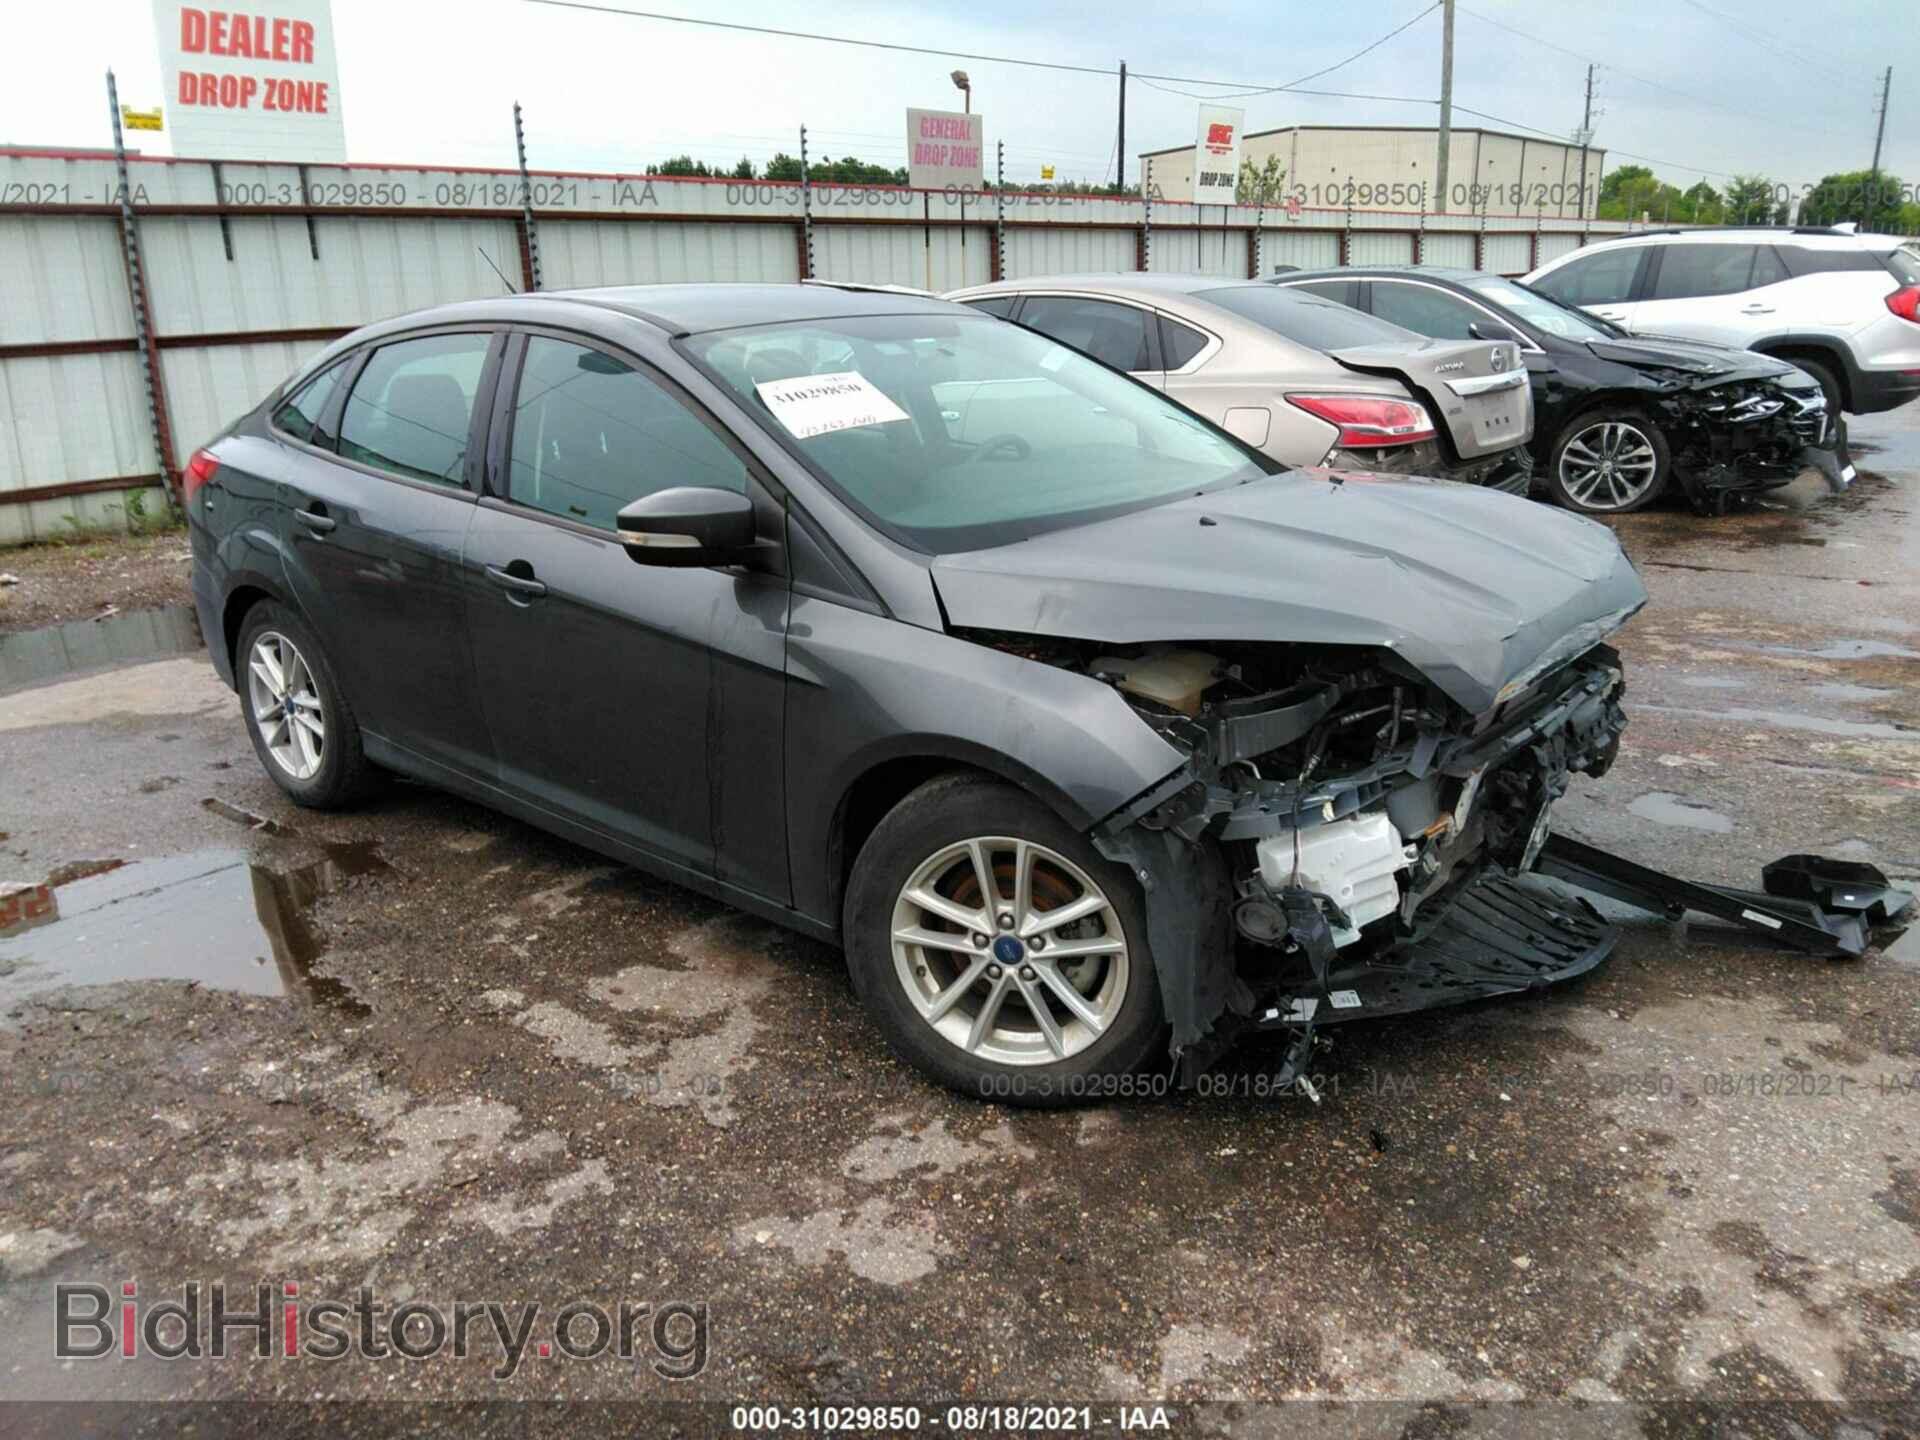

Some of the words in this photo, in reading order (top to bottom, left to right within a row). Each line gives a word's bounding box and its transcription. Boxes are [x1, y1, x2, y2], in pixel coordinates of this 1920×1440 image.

[180, 7, 314, 64] DEALER
[179, 71, 257, 108] DROP
[262, 77, 329, 114] ZONE
[920, 117, 971, 141] GENERAL
[913, 143, 949, 167] DROP
[949, 145, 979, 168] ZONE
